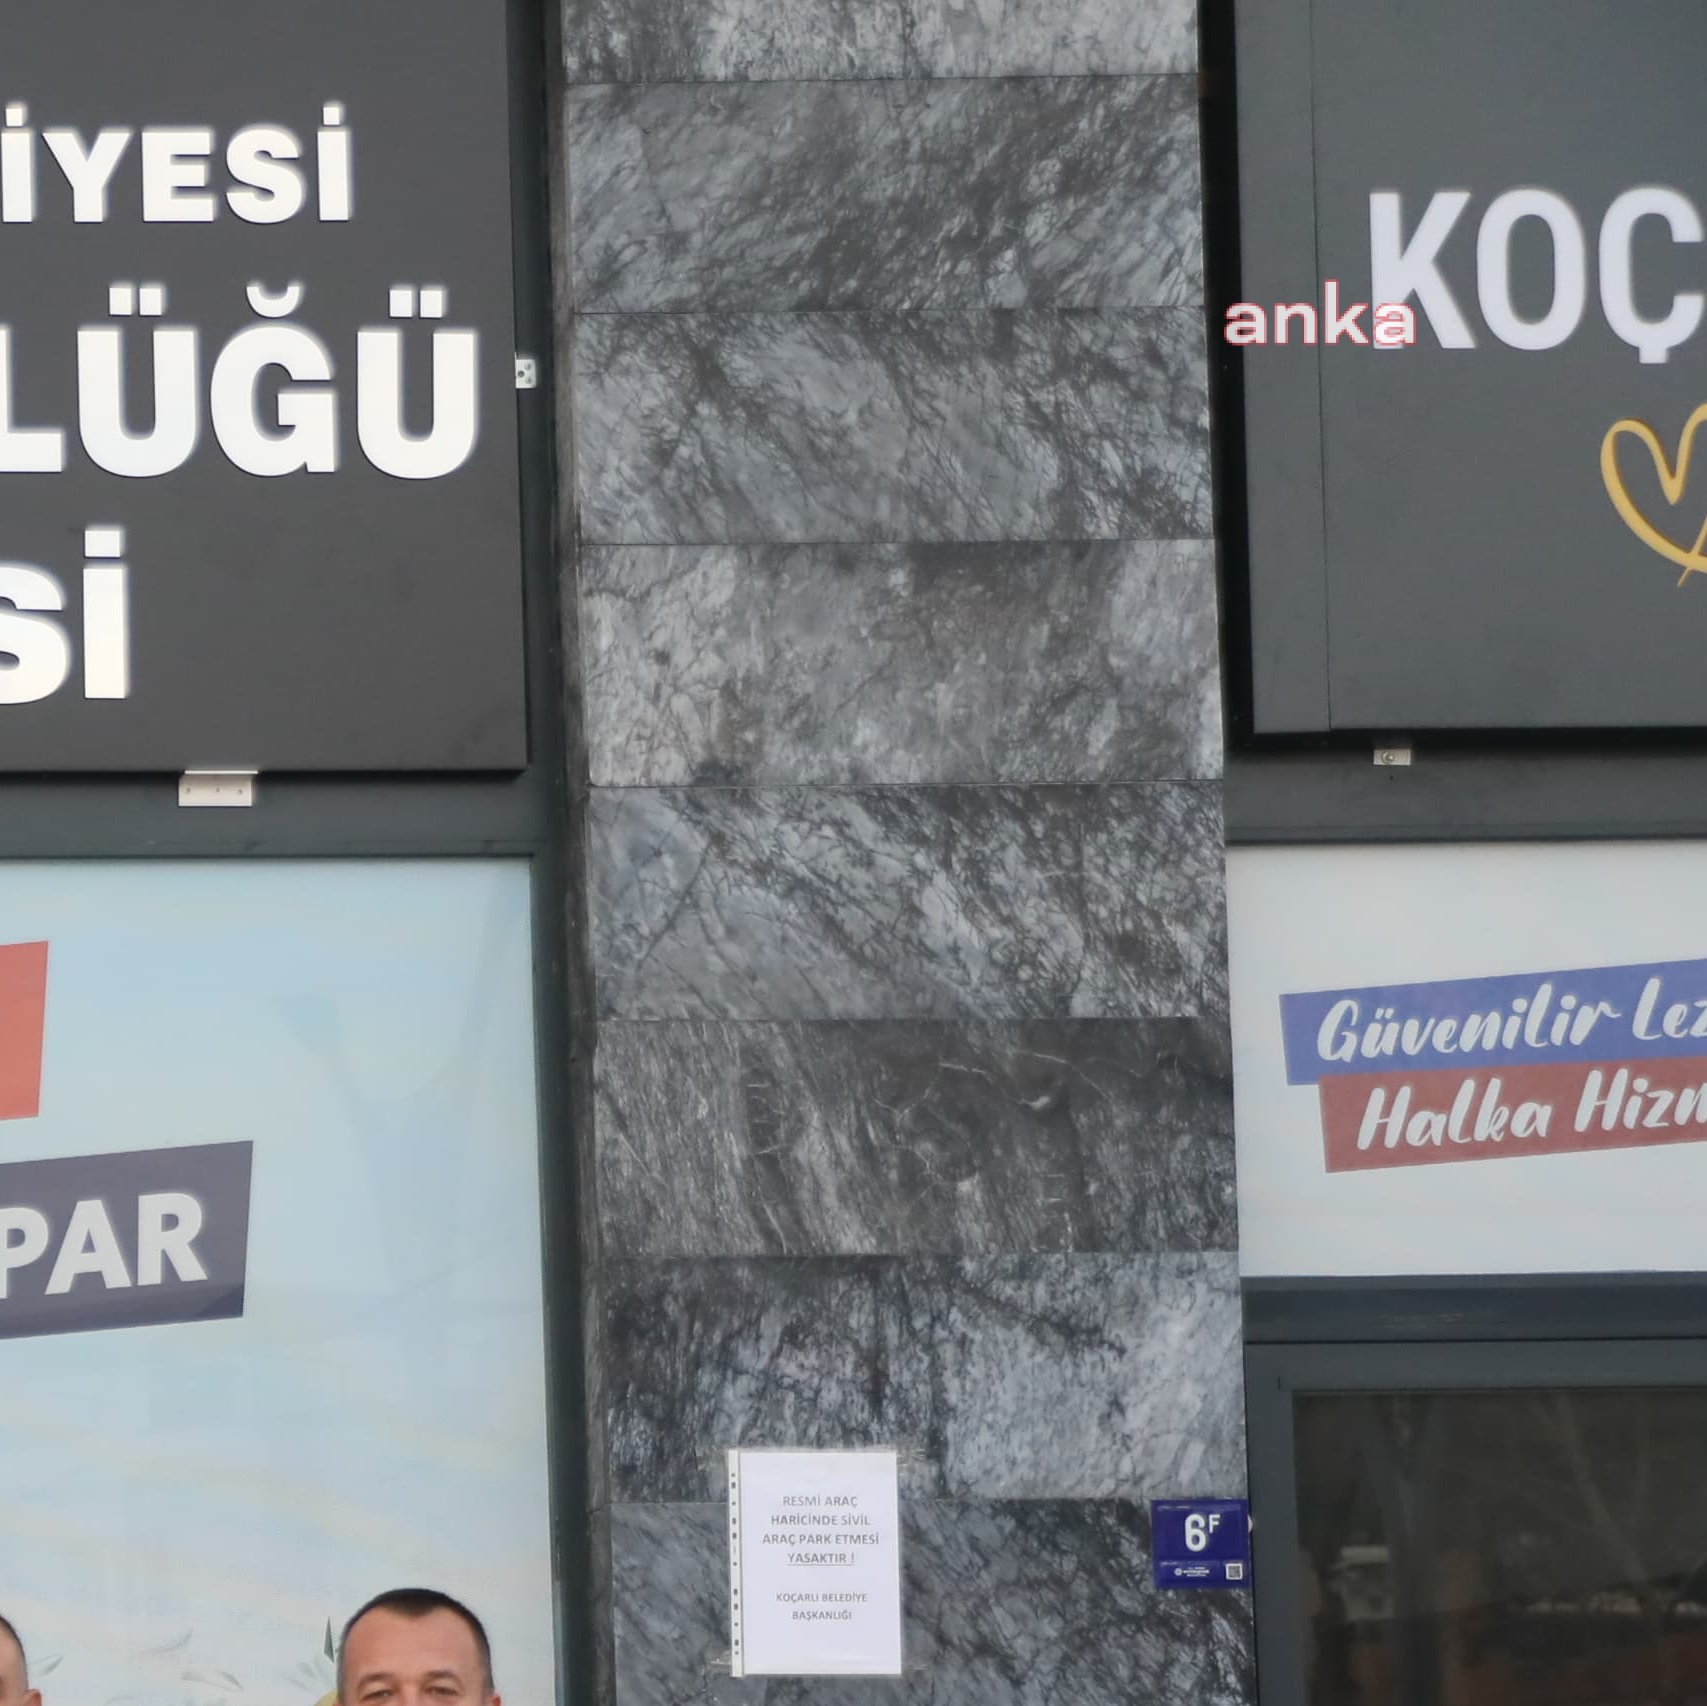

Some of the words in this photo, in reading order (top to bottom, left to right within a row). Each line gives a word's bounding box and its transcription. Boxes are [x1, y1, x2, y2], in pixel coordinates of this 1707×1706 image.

[1316, 982, 1621, 1063] Güvenilir
[1356, 1077, 1553, 1151] Halka
[782, 1494, 822, 1507] RESMİ
[824, 1496, 859, 1509] ARAÇ
[770, 1513, 839, 1526] HARİCİNDE
[841, 1513, 871, 1526] SİVİL
[762, 1533, 796, 1547] ARAÇ
[799, 1533, 832, 1545] PARK
[835, 1532, 880, 1545] ETMESİ
[1185, 1513, 1221, 1553] 6F
[787, 1553, 847, 1564] YASAKTIR
[776, 1593, 819, 1604] KOÇARLI
[822, 1592, 867, 1603] BELEDİYE
[792, 1609, 852, 1622] BAŞKANLIĞI
